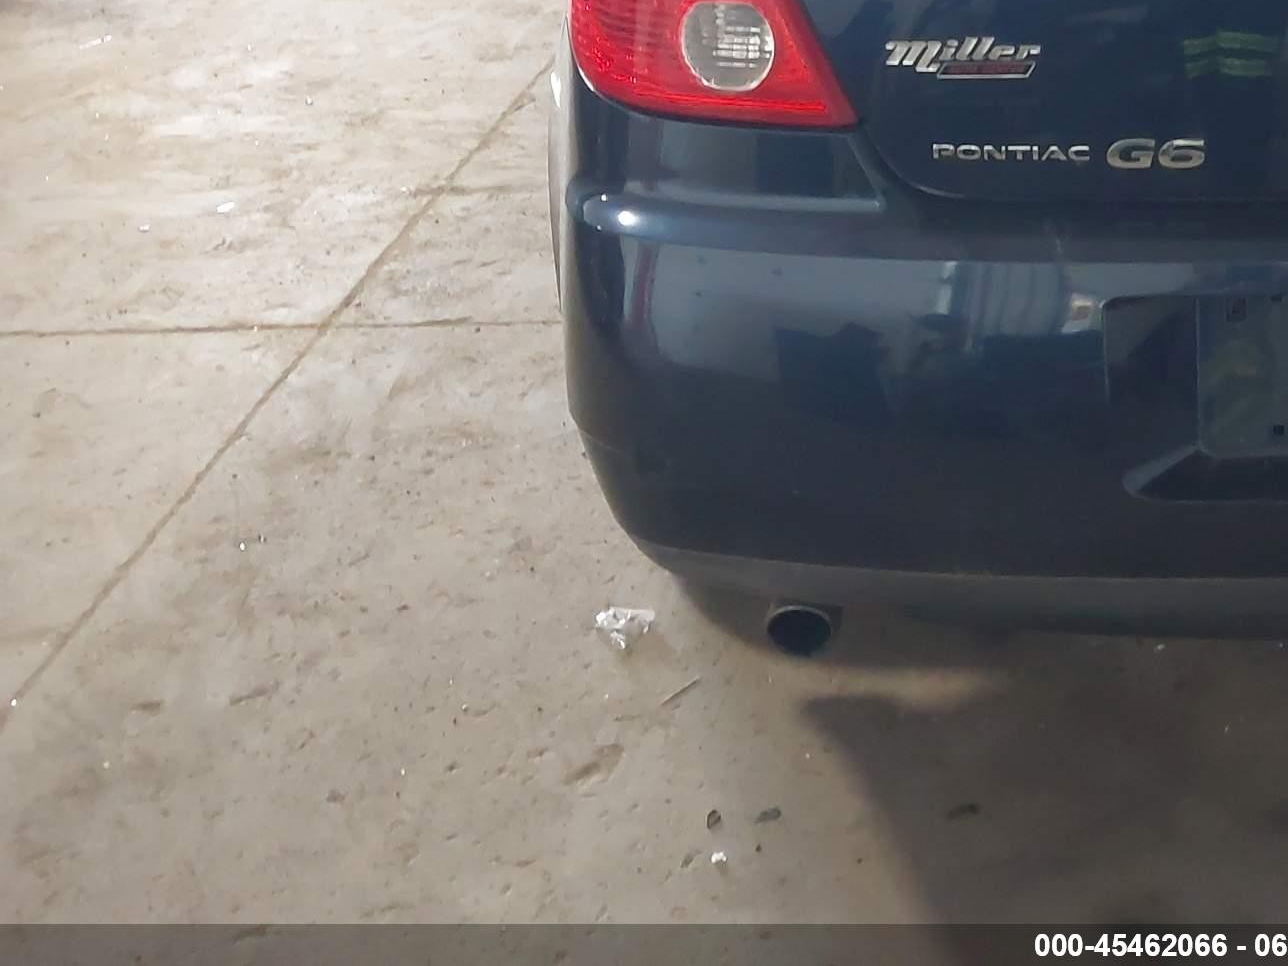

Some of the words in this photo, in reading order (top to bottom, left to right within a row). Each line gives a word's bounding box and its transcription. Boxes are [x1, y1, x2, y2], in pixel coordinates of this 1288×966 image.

[885, 36, 1041, 72] Miller
[931, 143, 1090, 162] PONTIAC
[1106, 138, 1205, 169] G6
